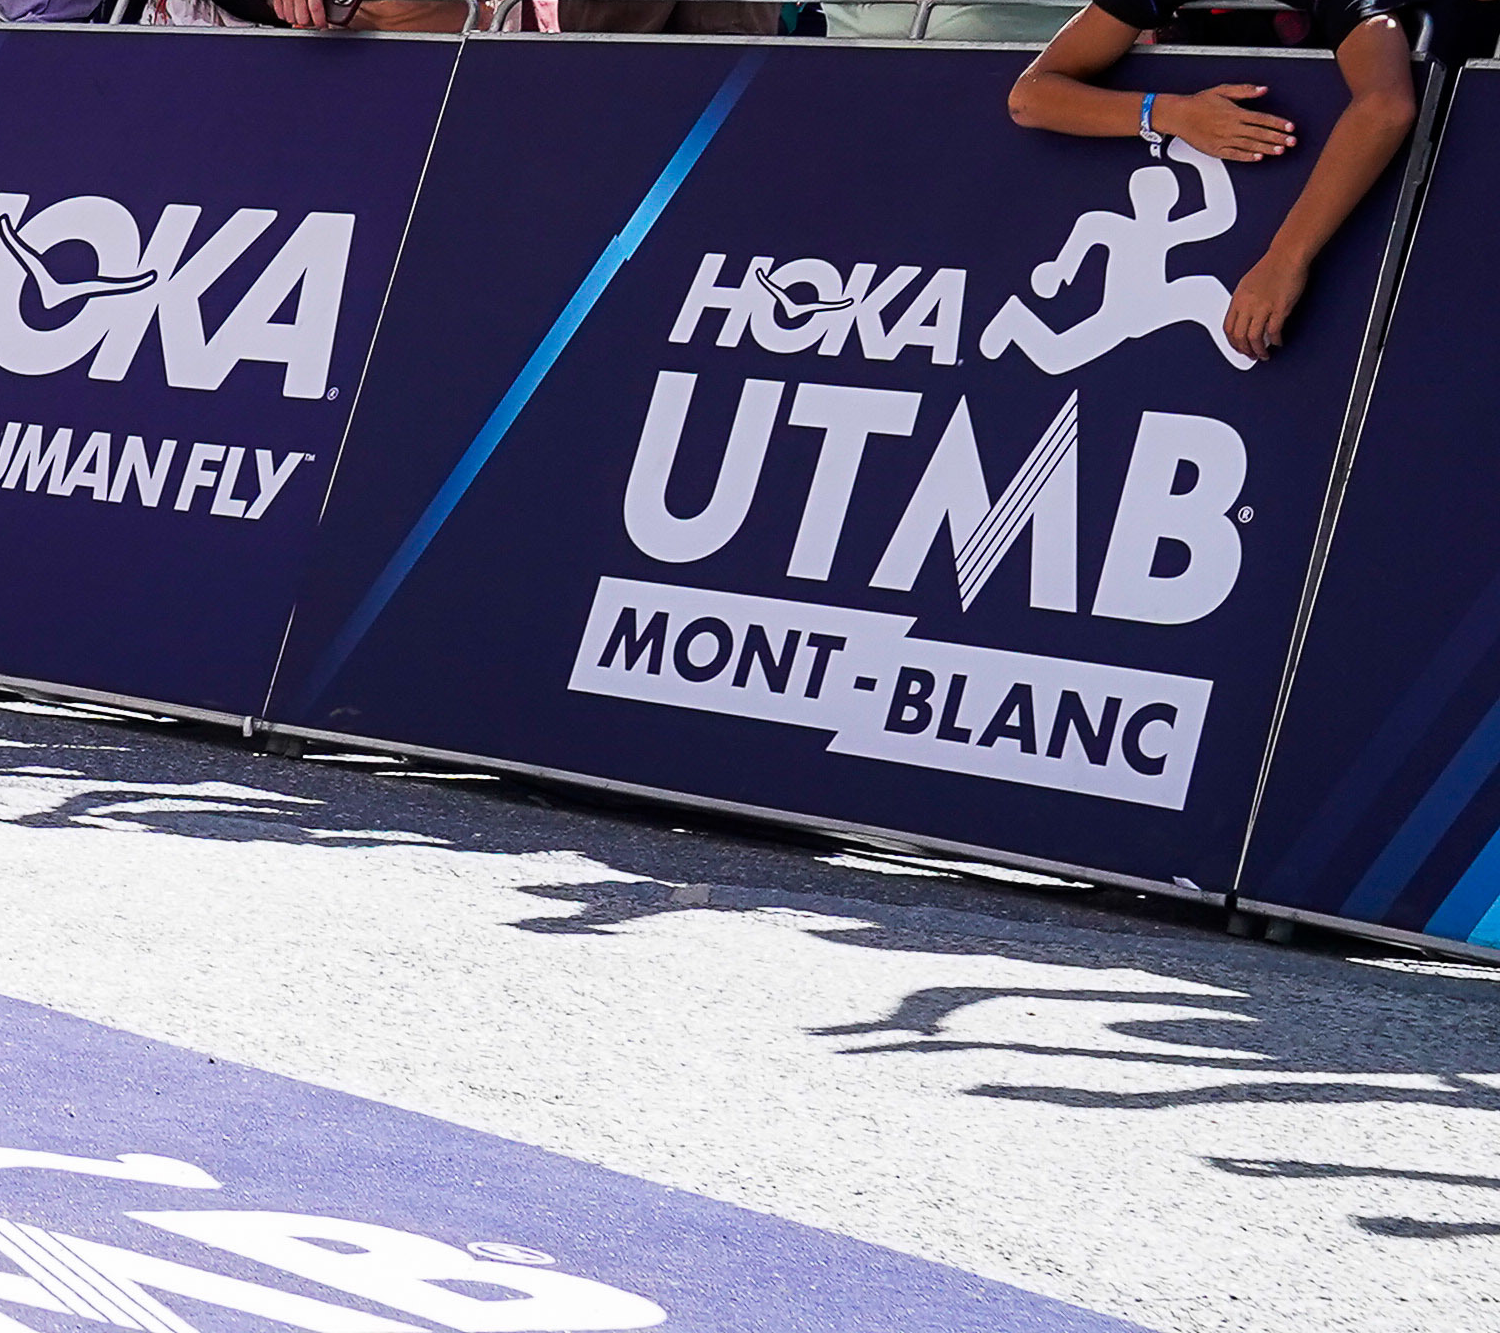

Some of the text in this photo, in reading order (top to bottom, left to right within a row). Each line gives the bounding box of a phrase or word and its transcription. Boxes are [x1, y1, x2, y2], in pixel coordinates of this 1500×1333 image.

[668, 252, 969, 367] HOKA
[174, 441, 305, 521] FLY
[622, 371, 1244, 627] UTMB
